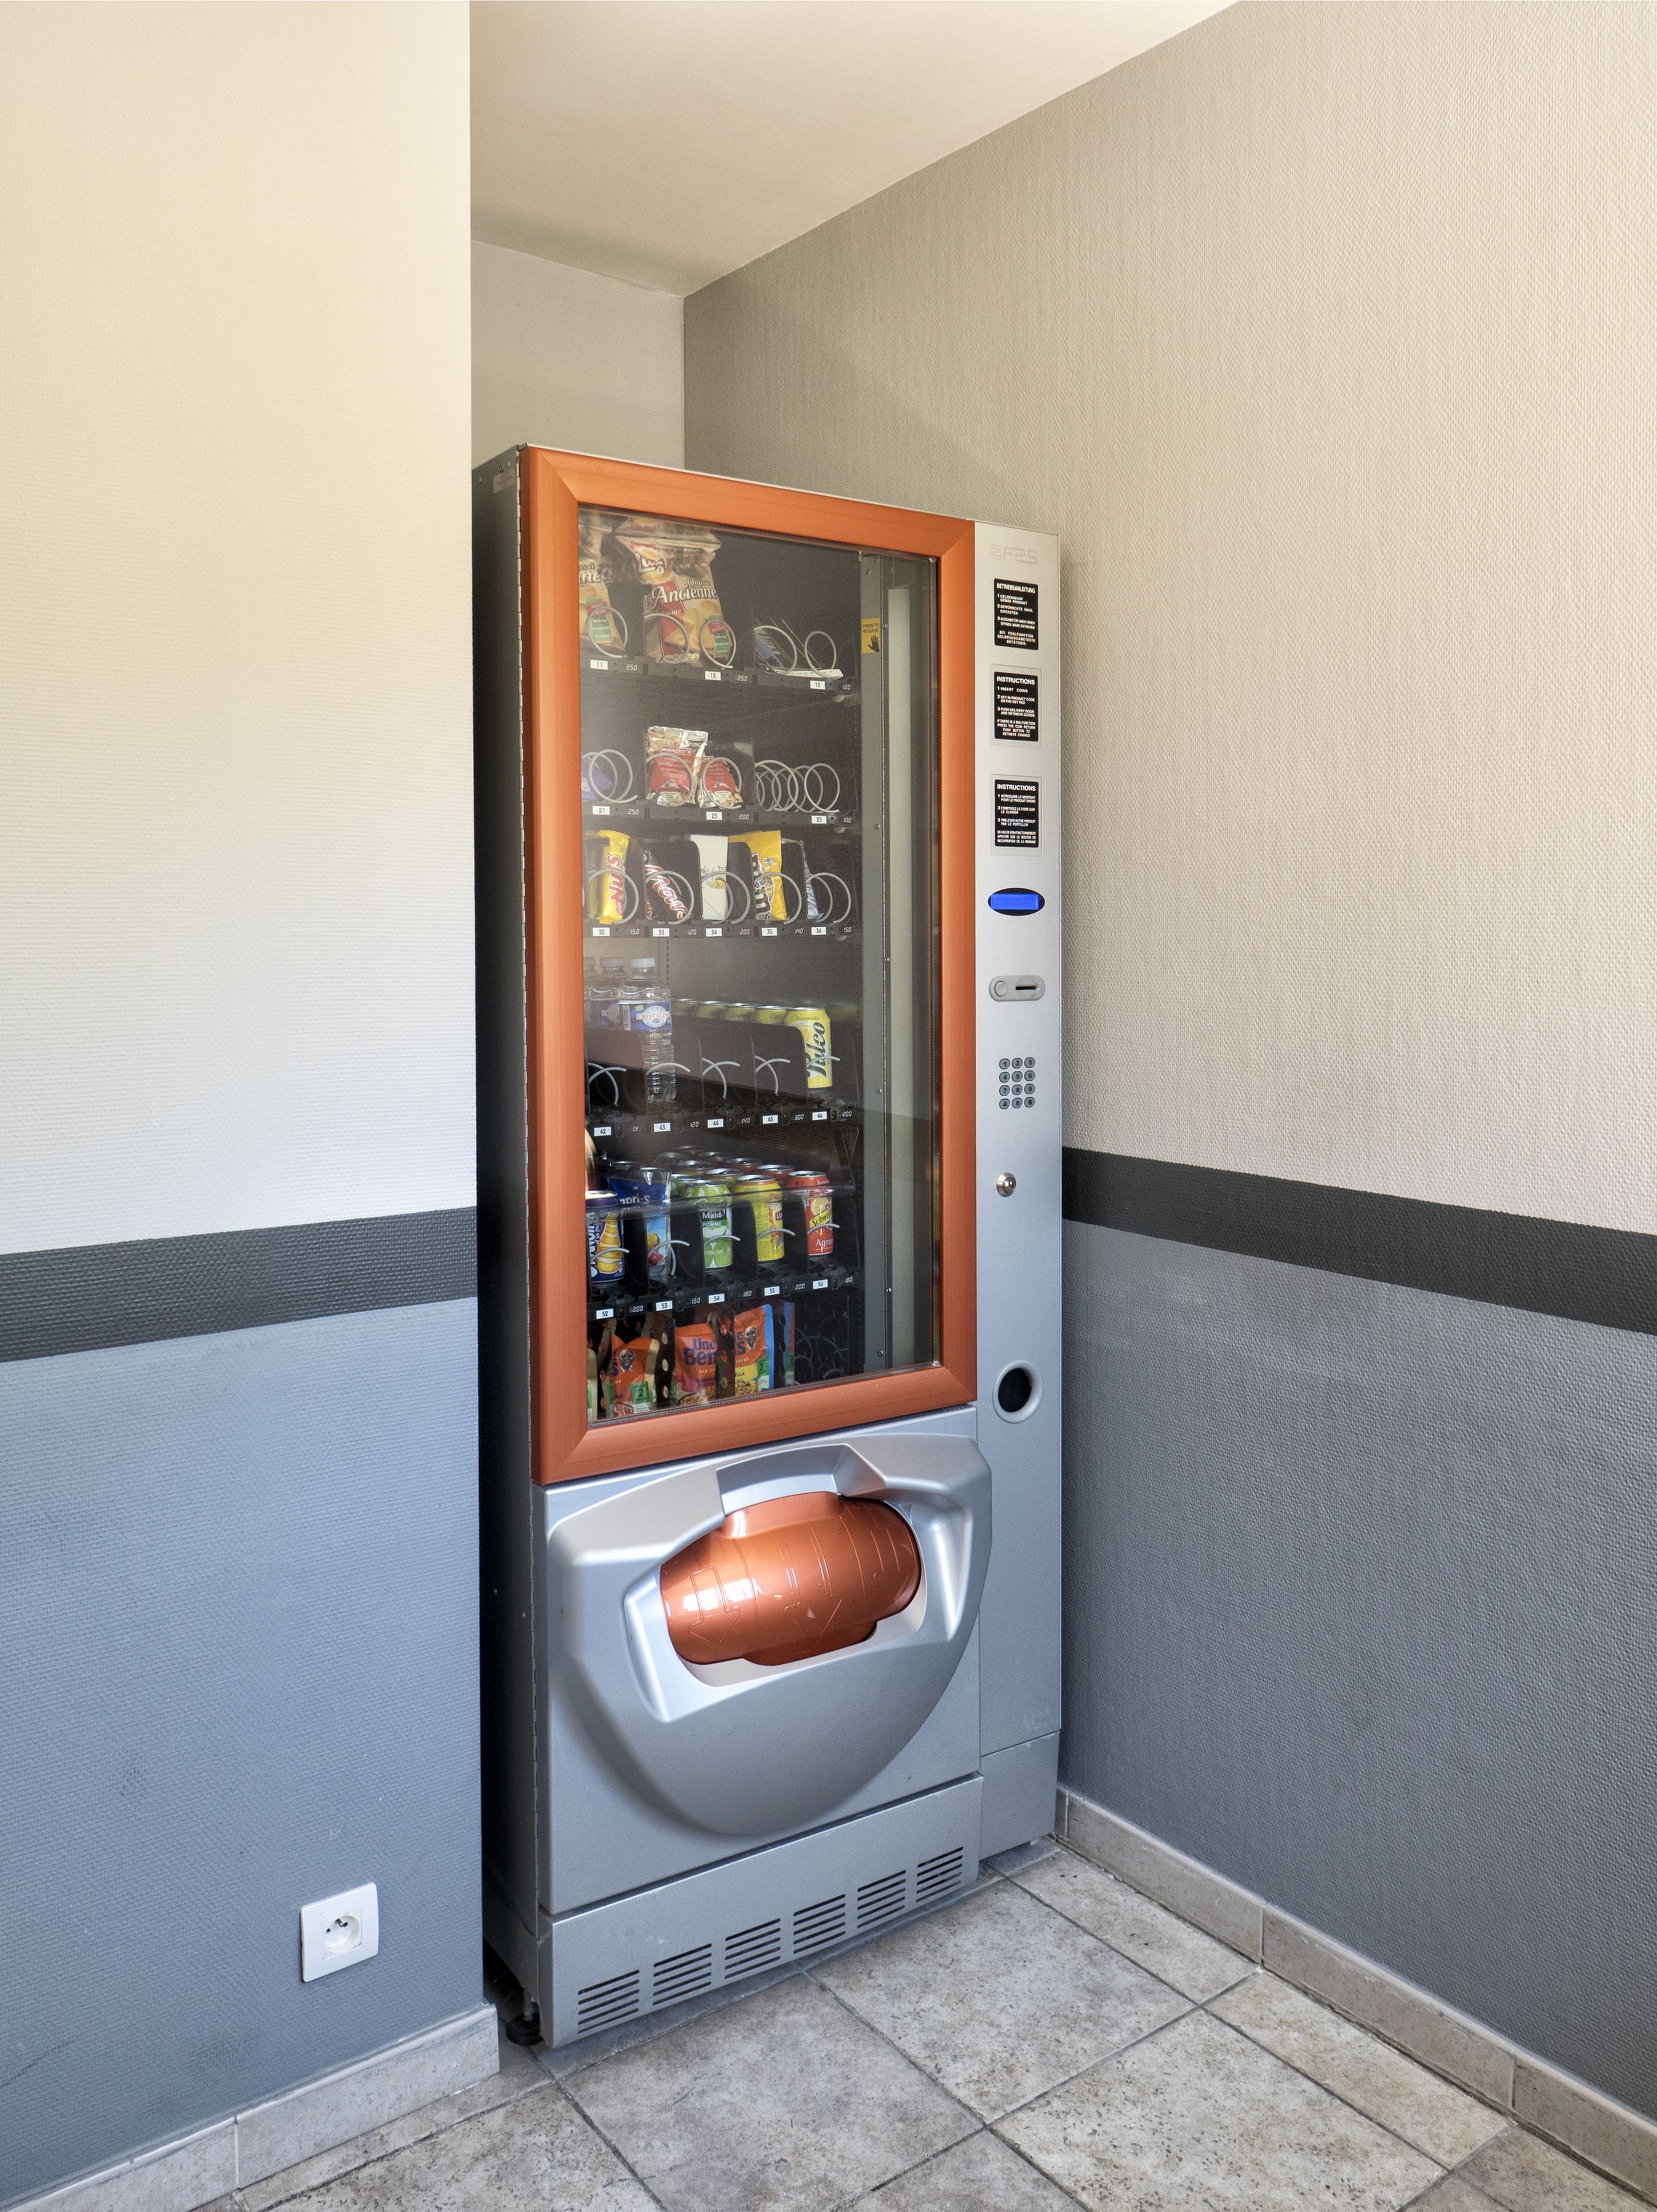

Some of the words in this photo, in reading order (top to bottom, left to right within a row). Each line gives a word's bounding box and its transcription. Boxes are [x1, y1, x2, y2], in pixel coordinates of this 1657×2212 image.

[997, 583, 1035, 593] BETRIEBSANLEITUNG
[997, 676, 1035, 684] INSTRUCTIONS
[638, 1388, 643, 1397] 2
